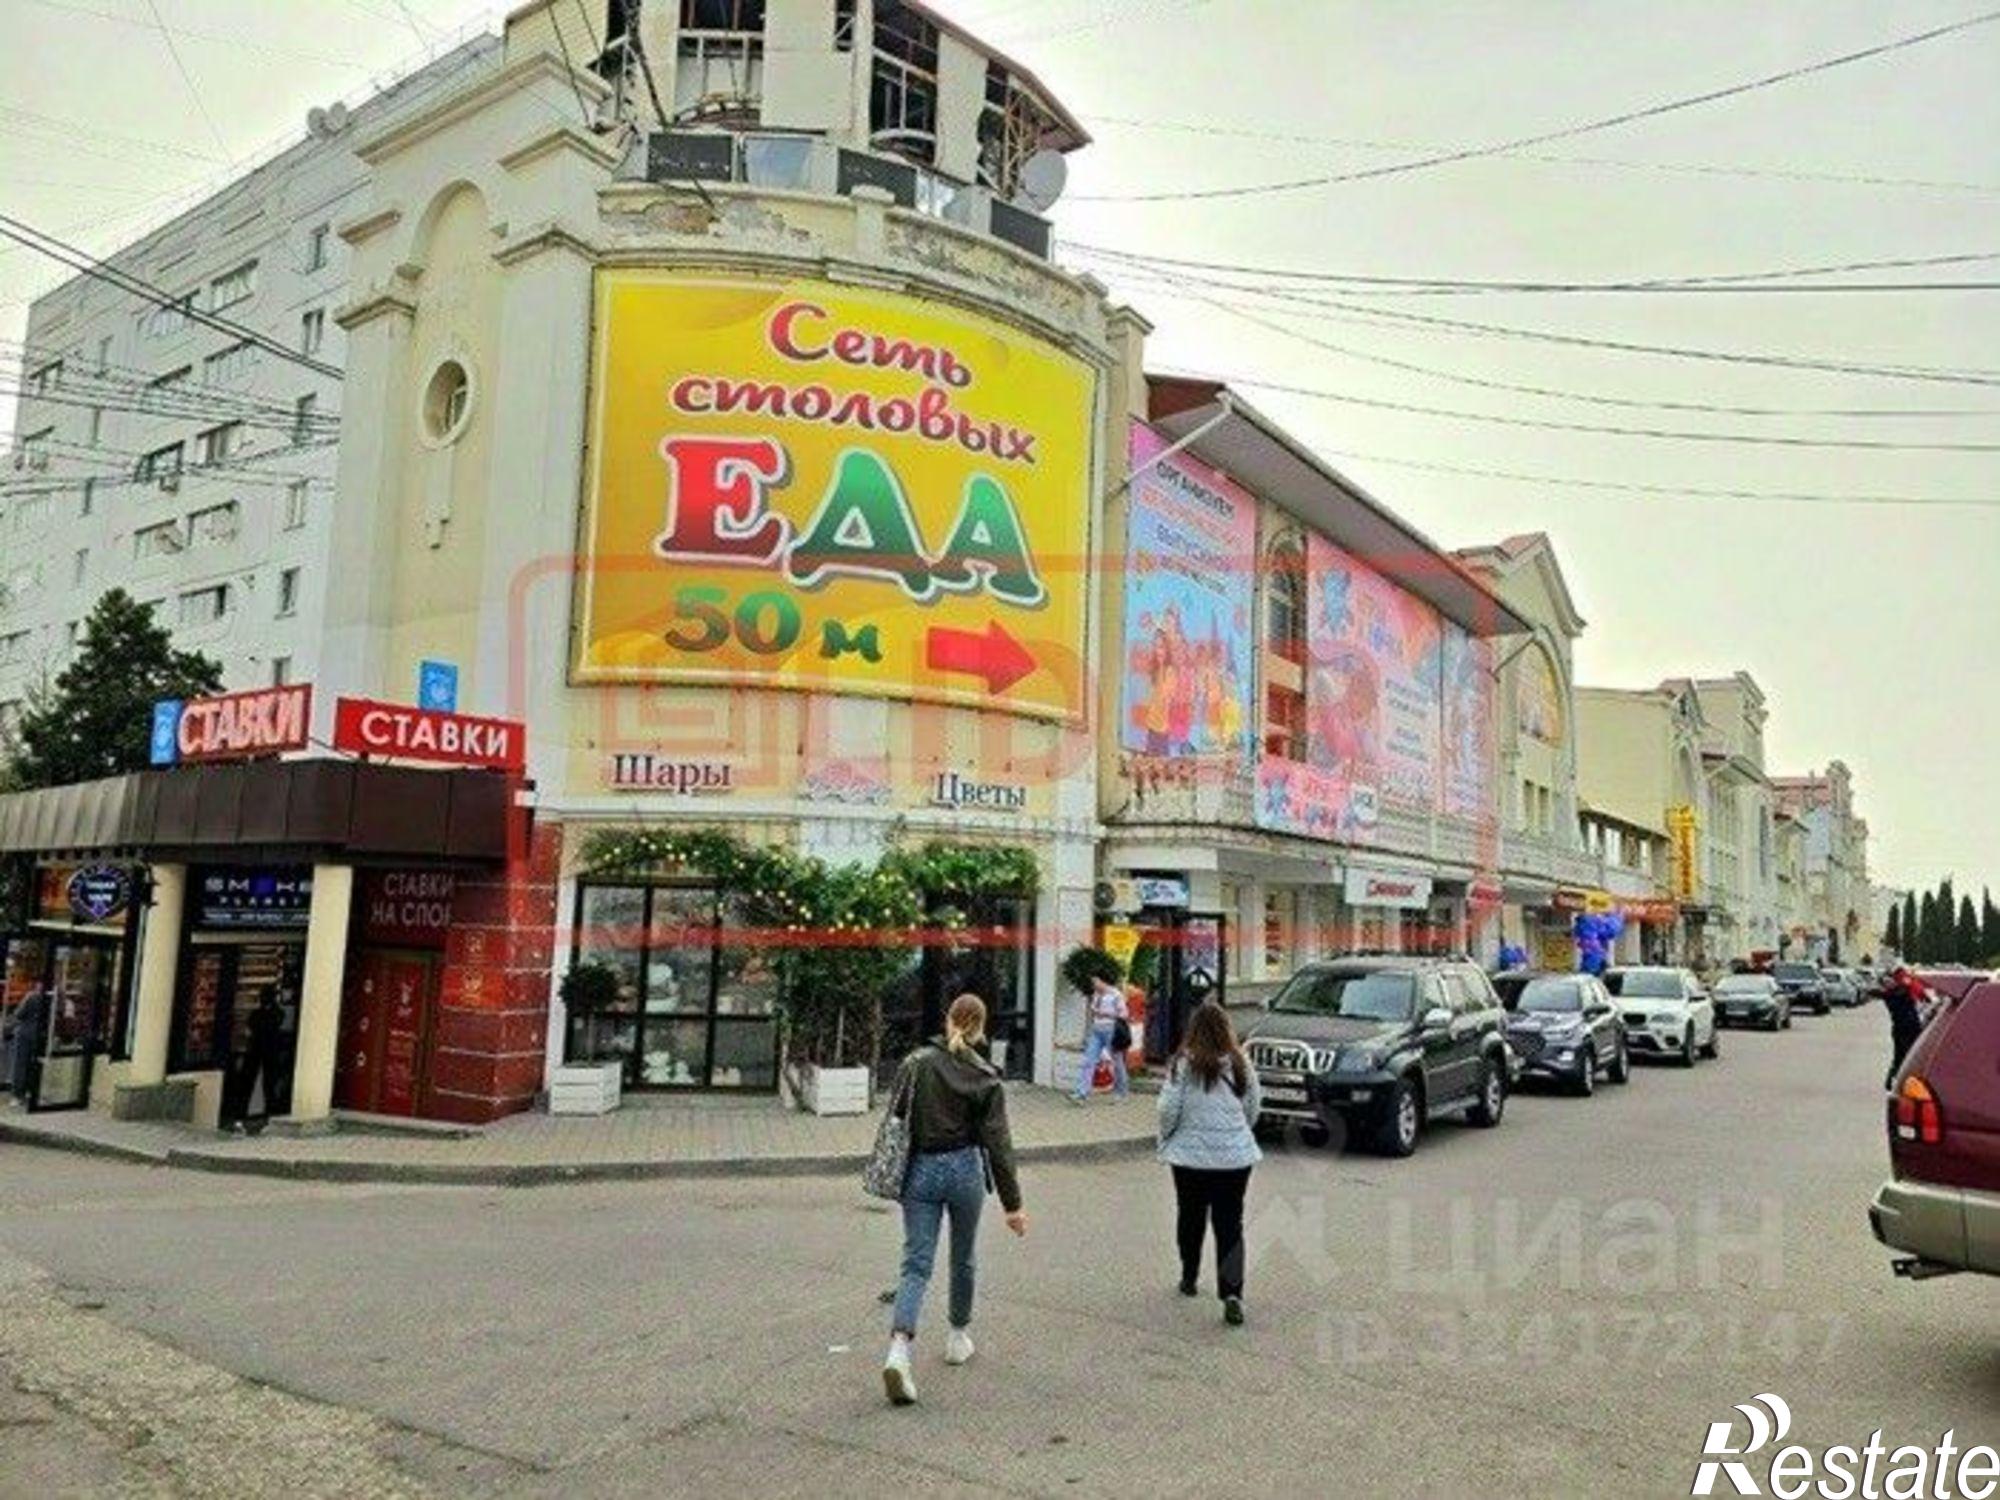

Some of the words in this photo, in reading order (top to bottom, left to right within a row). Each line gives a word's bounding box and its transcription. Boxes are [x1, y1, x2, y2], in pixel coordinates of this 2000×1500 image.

[768, 301, 974, 388] Сеть
[671, 375, 1037, 466] столовых
[654, 435, 1048, 609] ЕДА
[664, 585, 801, 655] 50
[820, 618, 883, 664] м
[177, 690, 301, 755] СТАВКИ
[361, 711, 508, 758] СТАВКИ
[612, 754, 731, 796] Шары
[935, 771, 1026, 808] Цветы
[371, 901, 398, 925] НА
[384, 873, 454, 897] СТАВКИ
